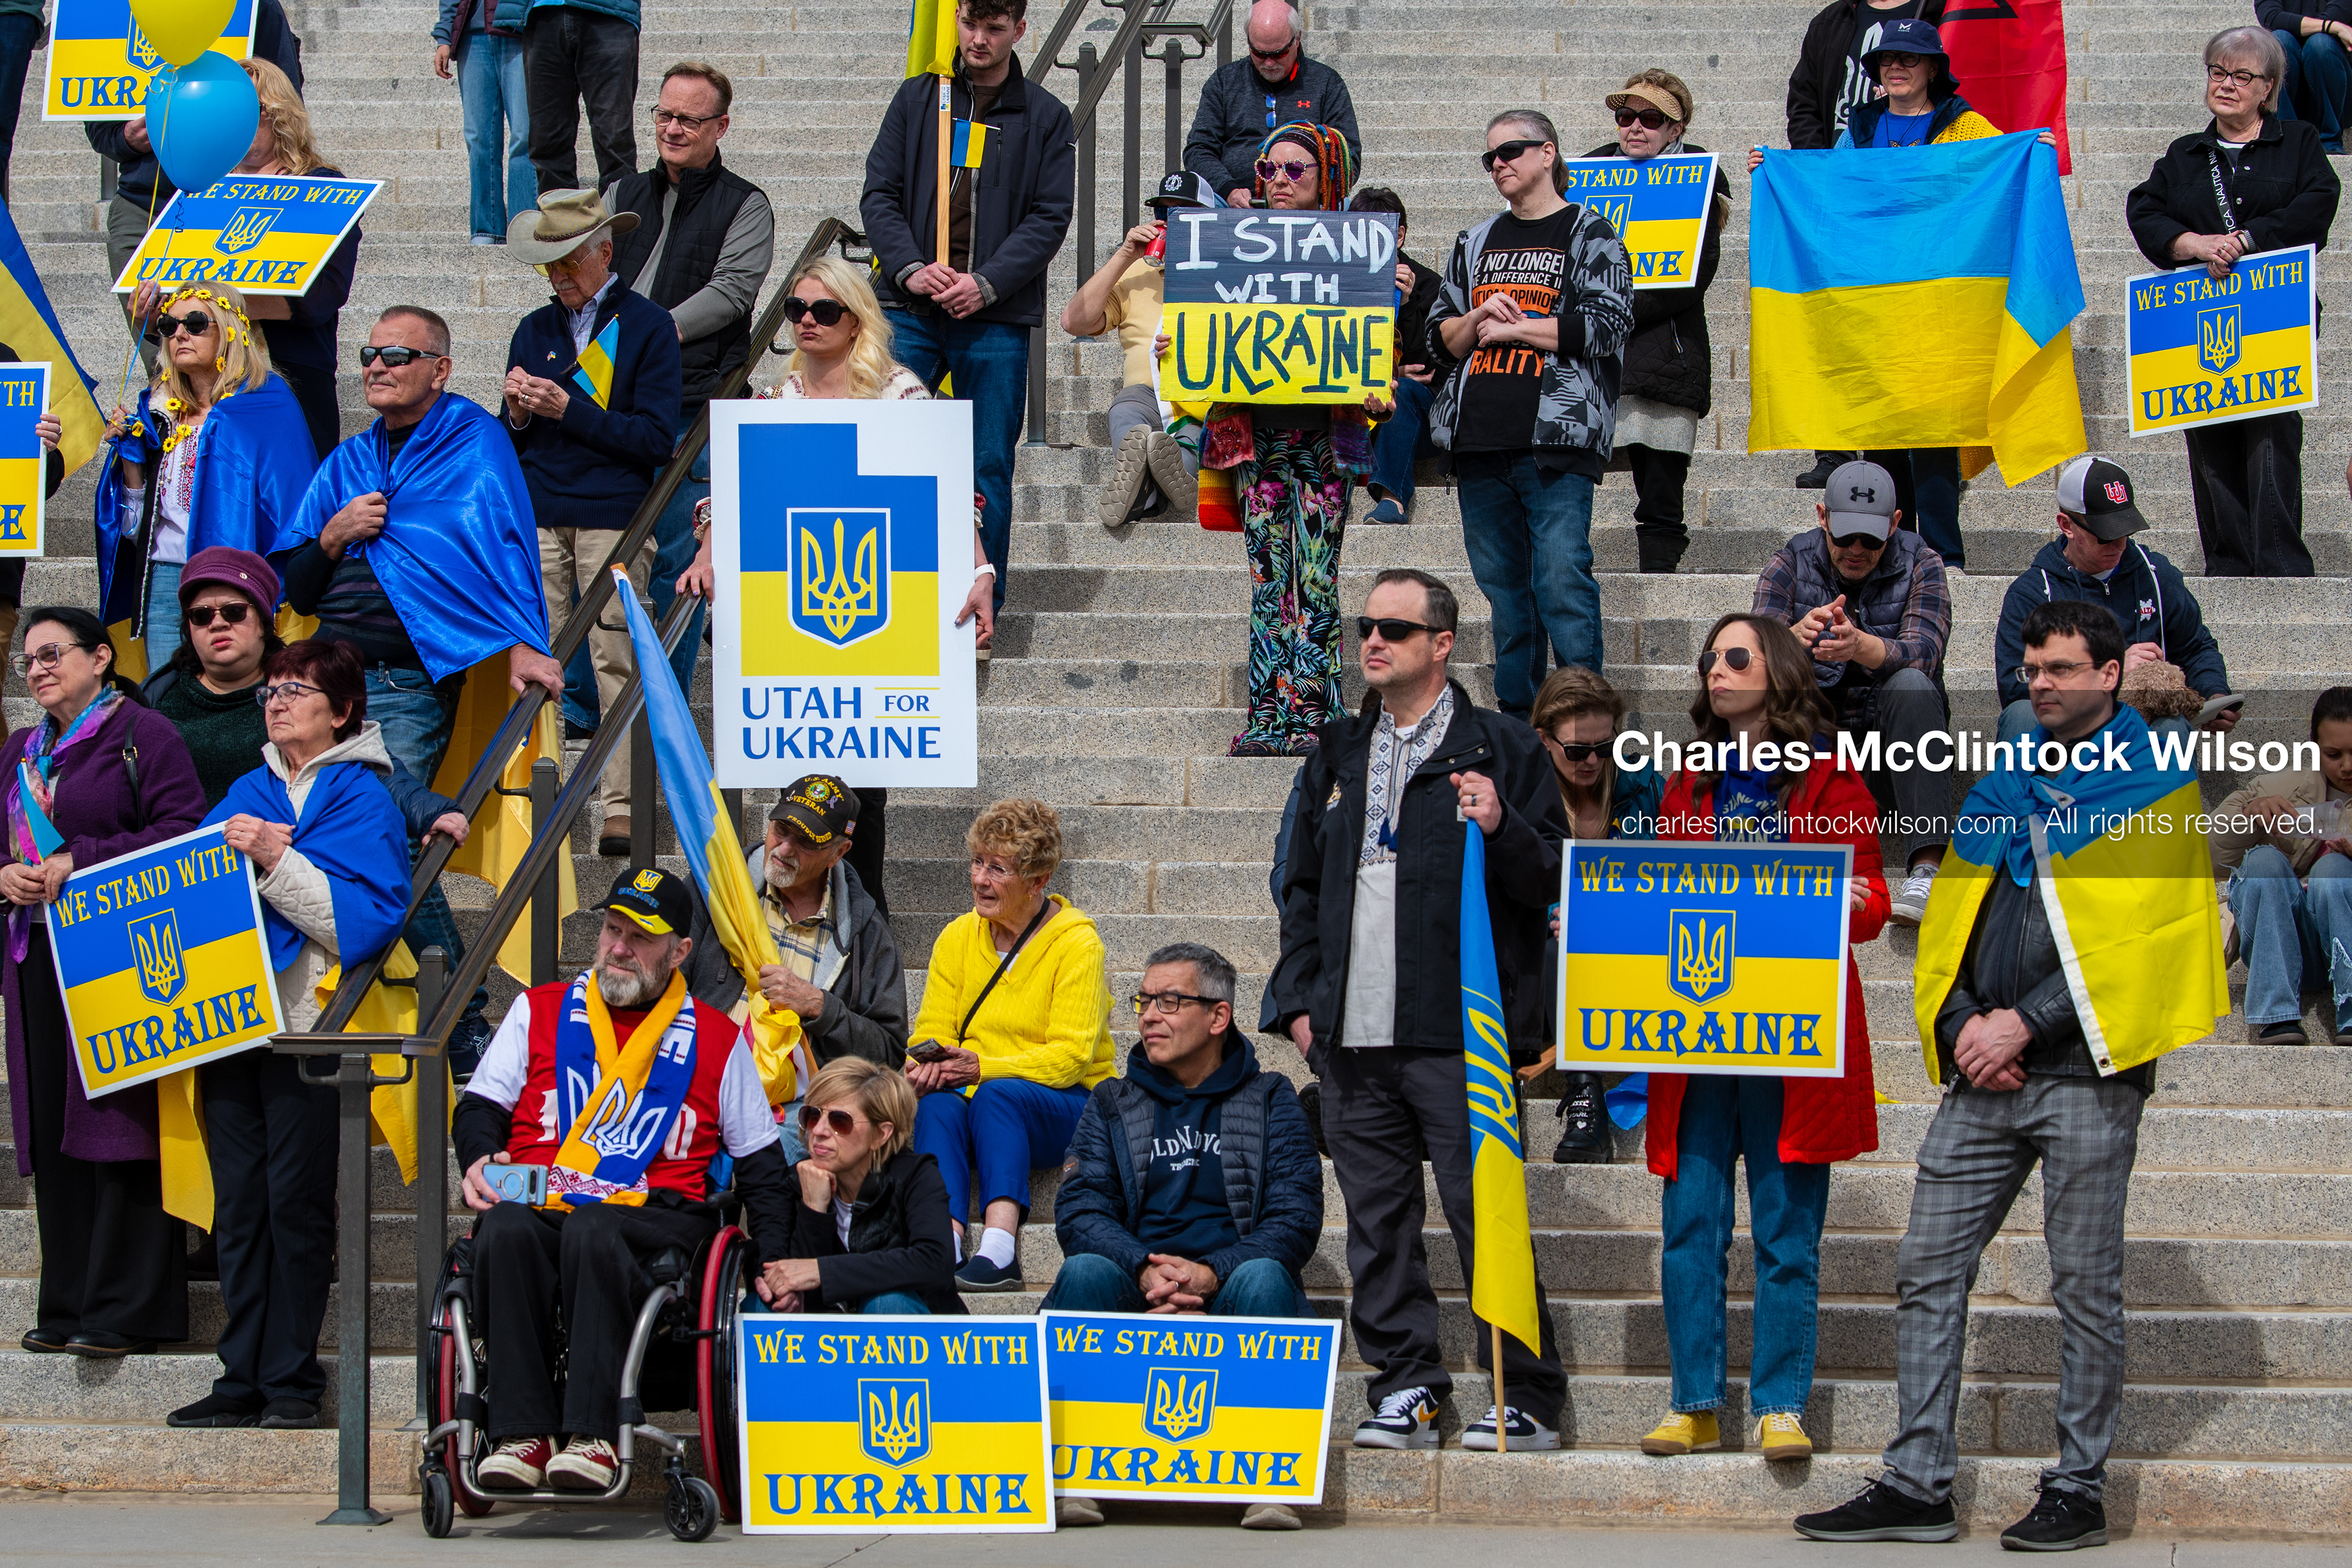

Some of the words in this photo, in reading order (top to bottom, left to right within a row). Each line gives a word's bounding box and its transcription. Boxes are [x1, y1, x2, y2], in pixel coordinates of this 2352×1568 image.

[1569, 167, 1638, 188] STAND
[1646, 163, 1705, 186] WITH
[2211, 165, 2228, 206] NAUTICA
[186, 183, 224, 199] E
[222, 184, 301, 201] STAND
[303, 186, 366, 205] WITH
[2223, 209, 2236, 235] ICA
[1175, 213, 1219, 271] I
[1232, 216, 1395, 274] STAND
[136, 257, 309, 285] UKRAINE
[1482, 273, 1488, 284] A
[1490, 271, 1553, 285] DIFFERENCE
[1483, 252, 1509, 273] NO
[1214, 272, 1340, 304] WITH
[2135, 282, 2167, 311] WE
[2173, 272, 2242, 306] STAND
[2248, 261, 2304, 291] WITH
[1176, 309, 1389, 396] UKRAINE
[1469, 348, 1545, 377] RALITY
[0, 380, 37, 407] TH
[2140, 364, 2305, 421] UKRAINE
[742, 686, 862, 720] UTAH
[884, 695, 930, 712] FOR
[742, 726, 941, 760] UKRAINE
[821, 777, 844, 799] ARMY
[793, 795, 826, 816] VETERAN
[786, 815, 816, 841] PROUDLY
[55, 888, 92, 929] WE
[96, 865, 171, 917] STAND
[175, 844, 239, 889] WITH
[1578, 854, 1626, 892] WE
[1634, 861, 1740, 895] STAND
[1751, 858, 1836, 897] WITH
[617, 887, 660, 909] UKRAINE
[85, 983, 268, 1075] UKRAINE
[1577, 1007, 1824, 1058] UKRAINE
[752, 1327, 807, 1364] WE
[817, 1334, 929, 1365] STAND
[940, 1329, 1029, 1365] WITH
[1054, 1322, 1105, 1354] WE
[1114, 1329, 1225, 1358] STAND
[1237, 1329, 1322, 1361] WITH
[1051, 1444, 1303, 1487] UKRAINE
[762, 1473, 1034, 1520] UKRAINE
